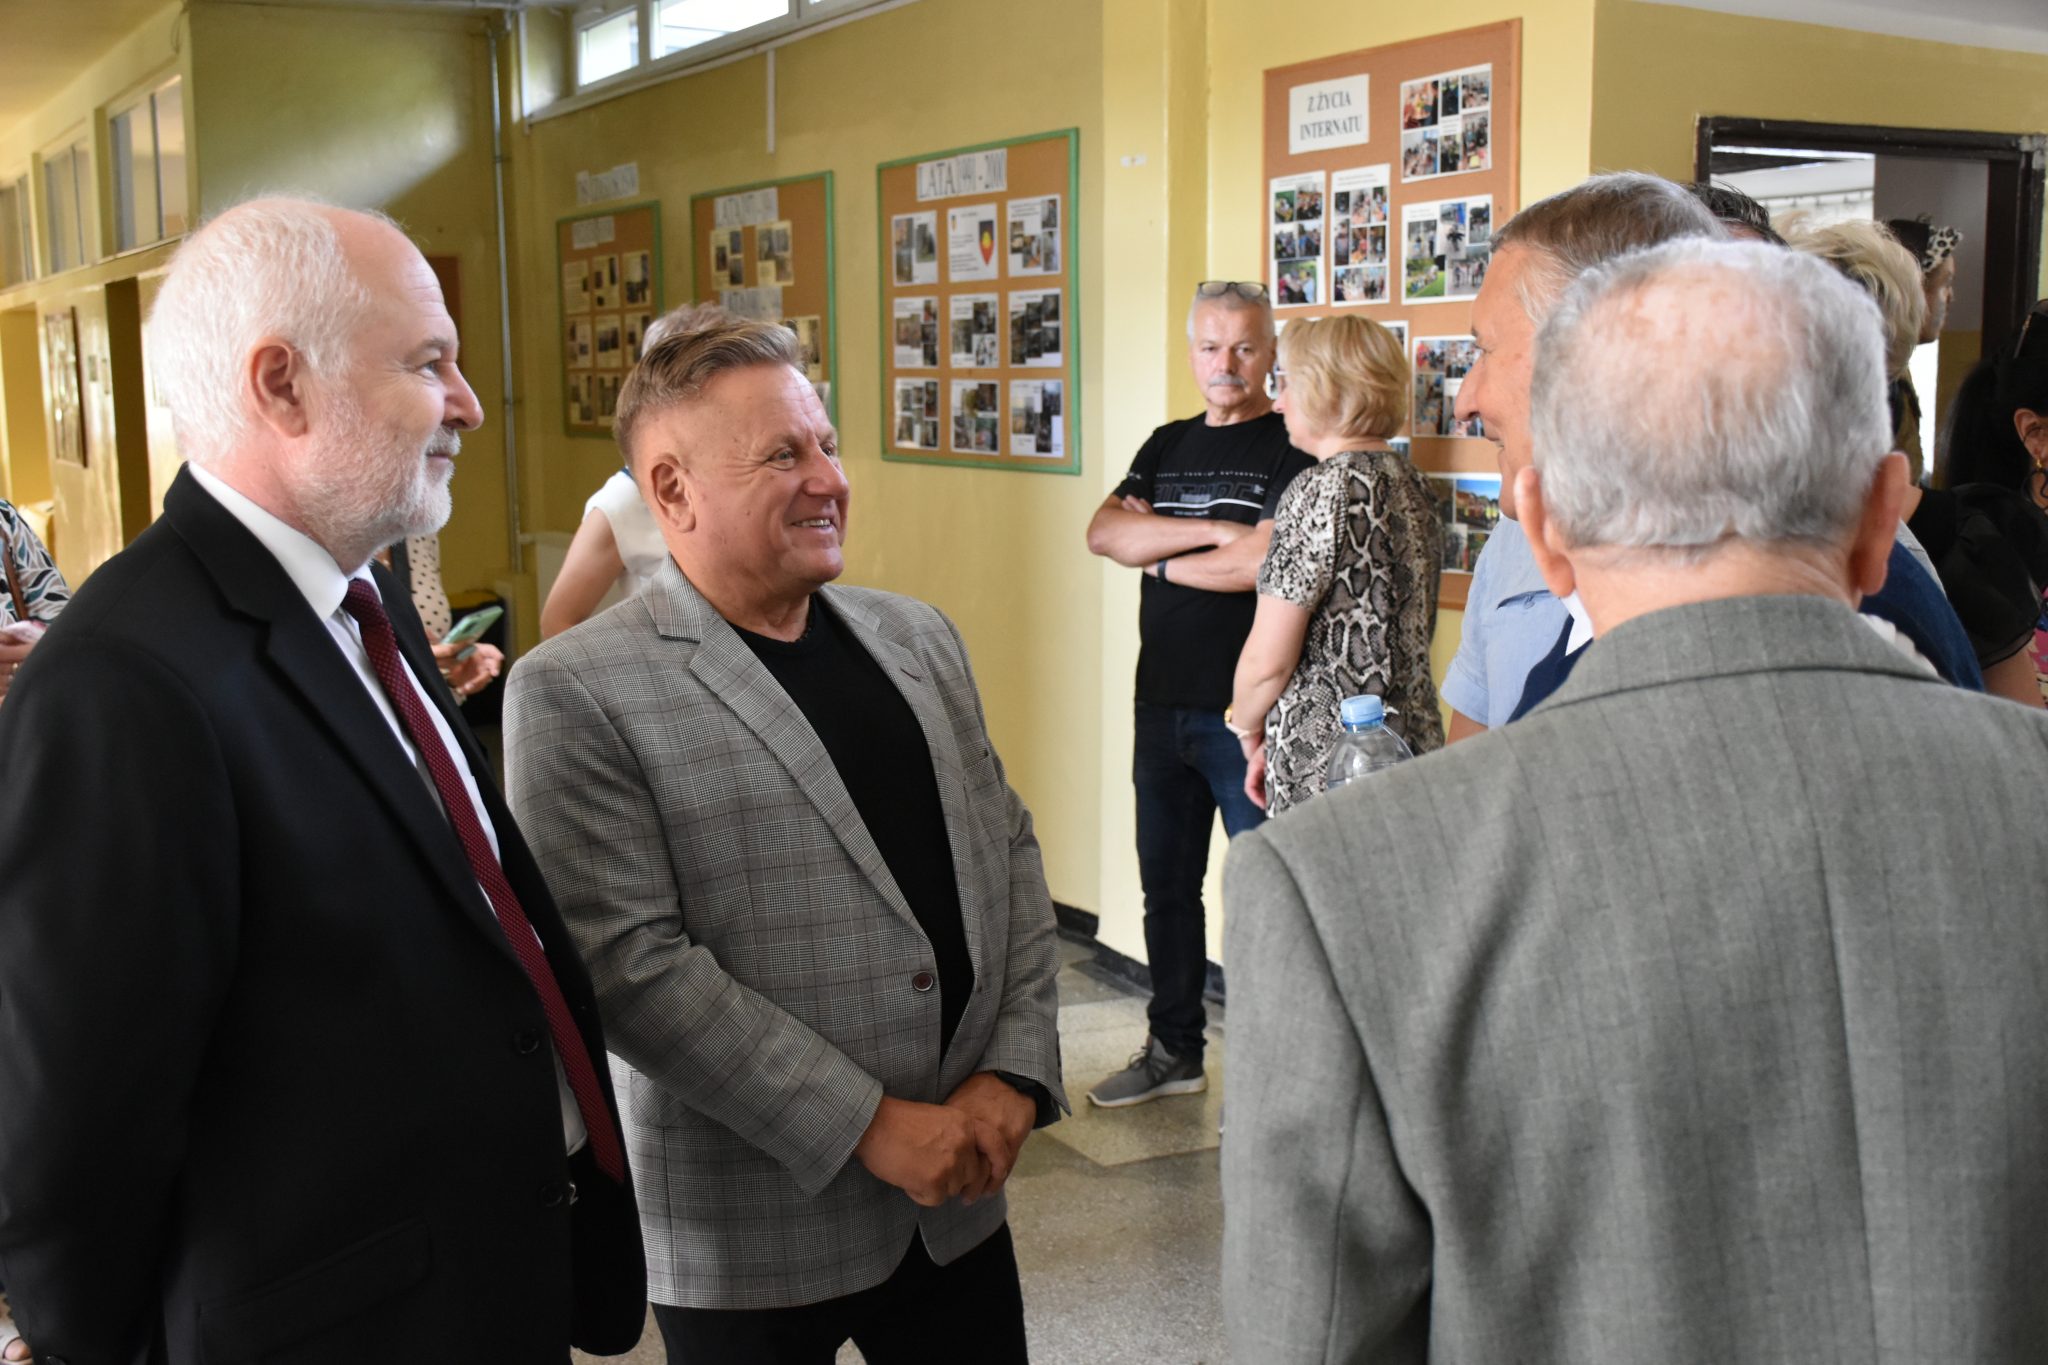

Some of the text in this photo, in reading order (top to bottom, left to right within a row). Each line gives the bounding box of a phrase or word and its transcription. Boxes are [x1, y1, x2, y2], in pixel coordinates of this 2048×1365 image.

[1307, 90, 1352, 113] Z ŻYCIA
[1300, 114, 1362, 141] INTERNATU
[919, 162, 957, 199] LATA
